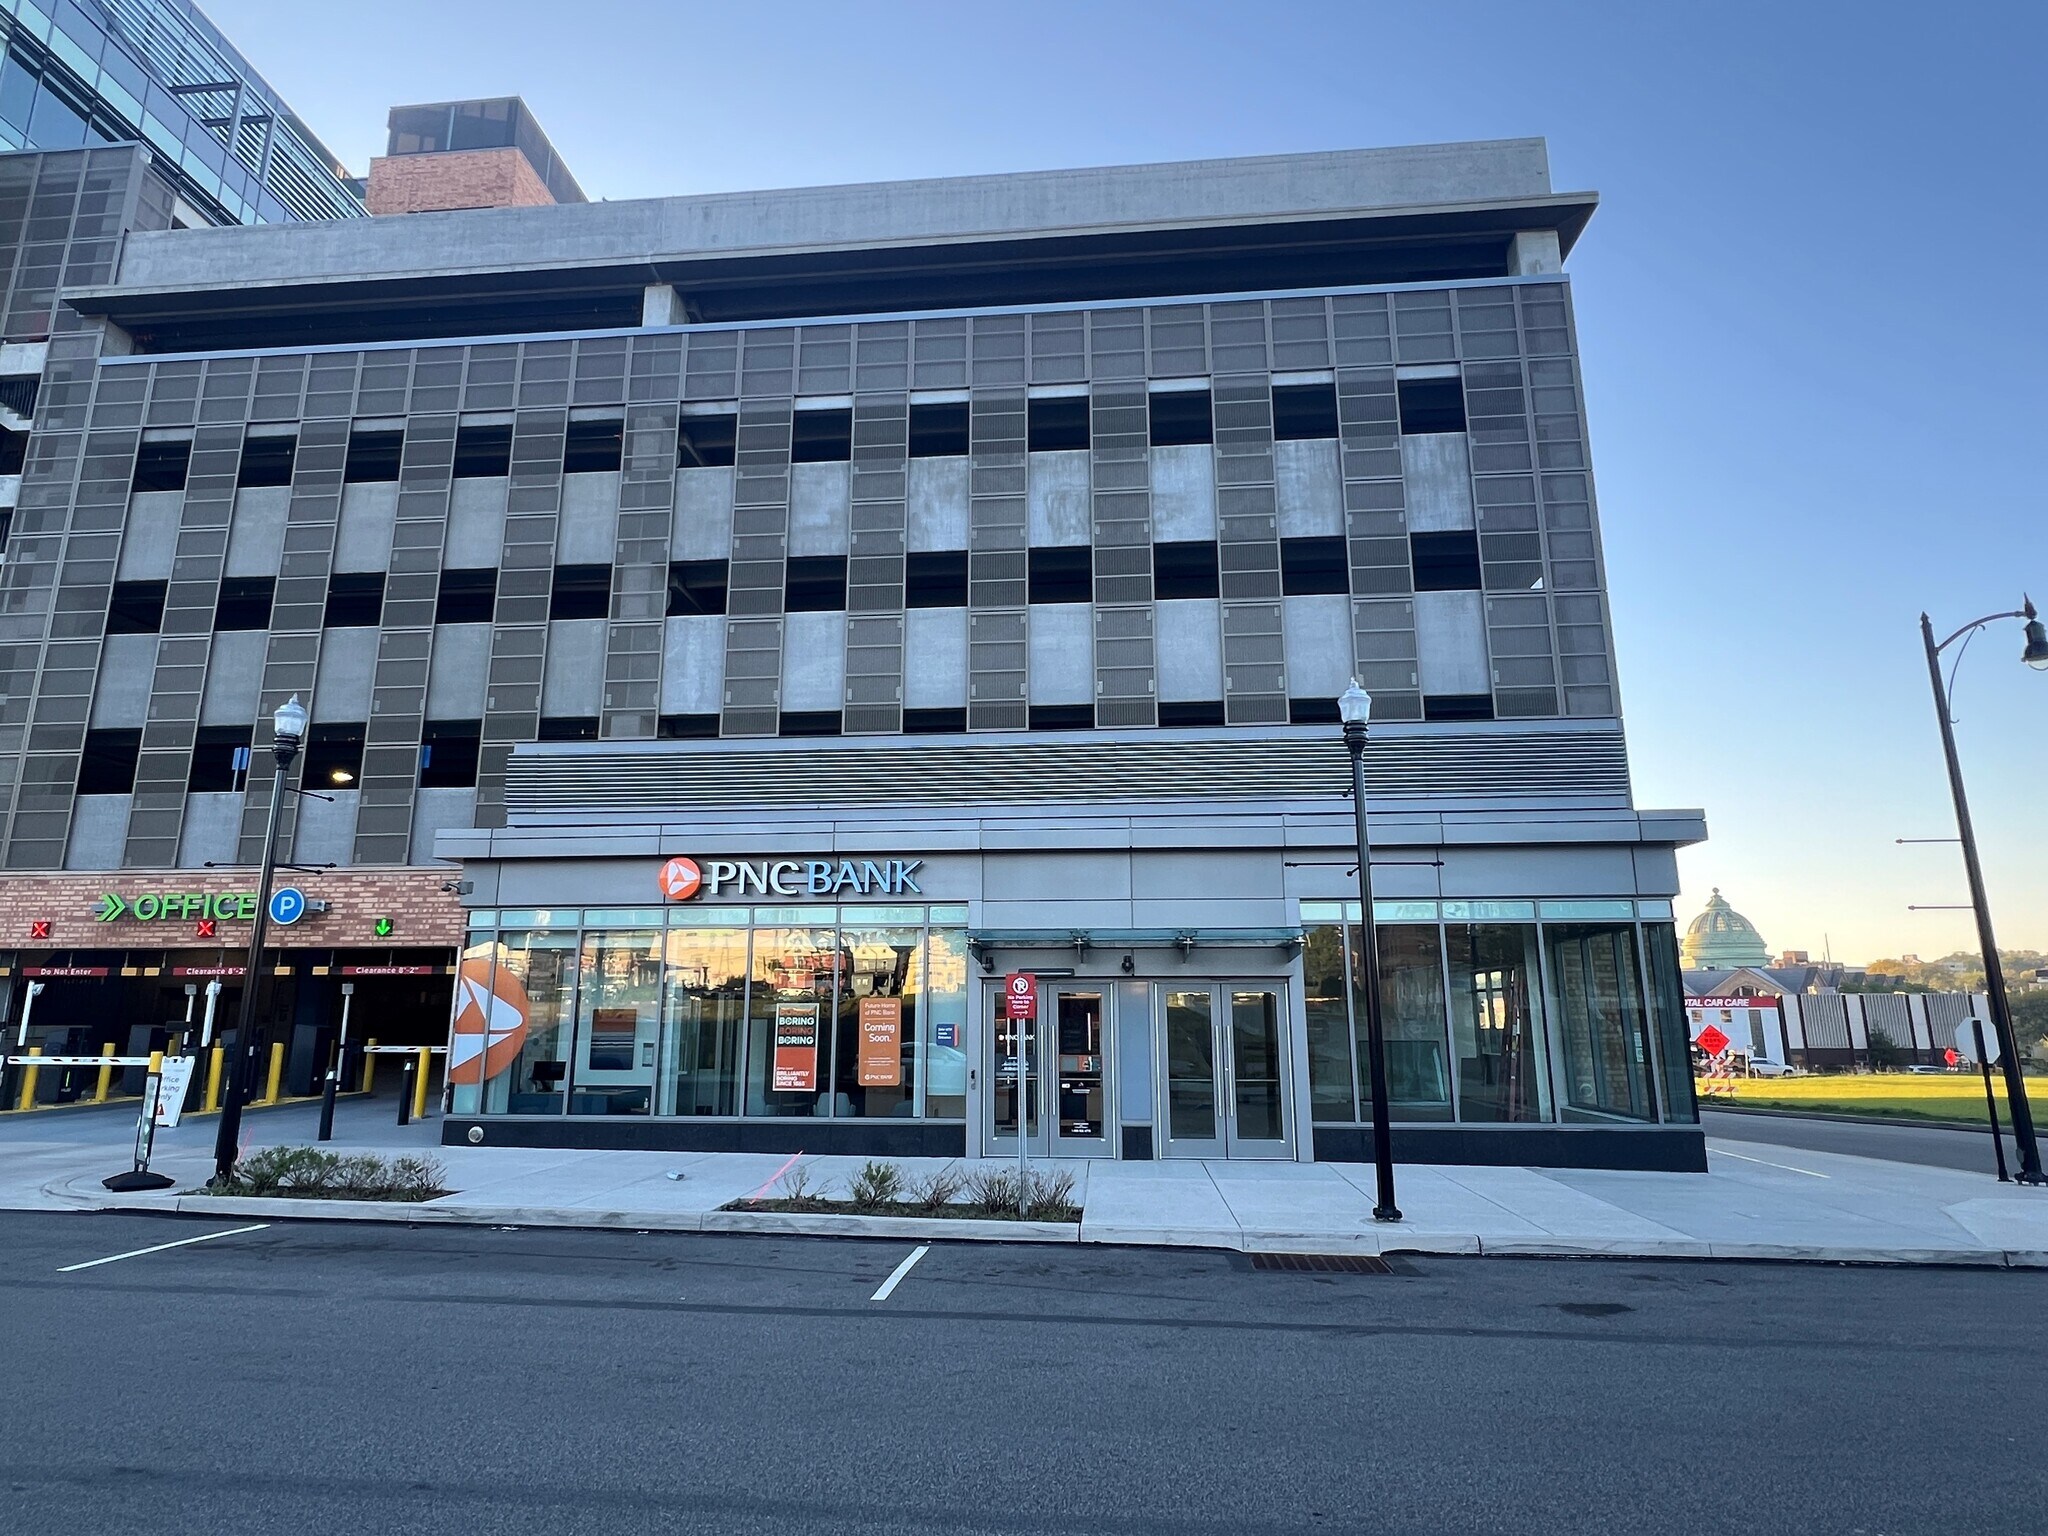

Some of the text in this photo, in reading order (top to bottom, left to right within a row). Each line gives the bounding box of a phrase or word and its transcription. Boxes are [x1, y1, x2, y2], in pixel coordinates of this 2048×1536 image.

[133, 893, 257, 920] OFFICE
[40, 968, 92, 976] Do Not Enter
[186, 967, 225, 976] Clearance
[355, 966, 396, 975] Clearance
[1704, 999, 1723, 1007] CAR
[1725, 999, 1749, 1007] CARE
[779, 1017, 815, 1026] BORING
[864, 1023, 896, 1034] Coming
[778, 1036, 815, 1045] BORING
[869, 1033, 892, 1043] Soon.
